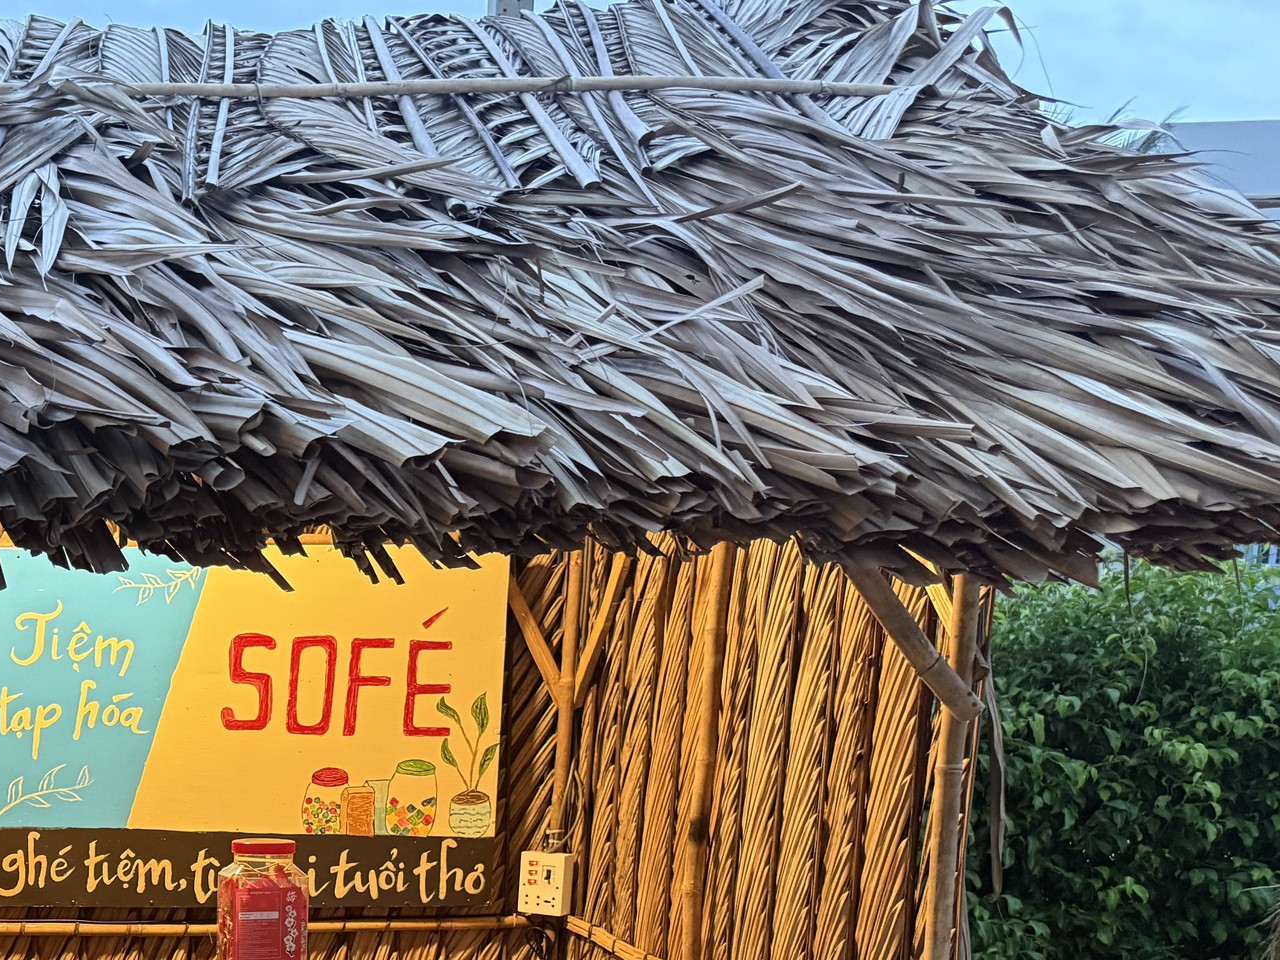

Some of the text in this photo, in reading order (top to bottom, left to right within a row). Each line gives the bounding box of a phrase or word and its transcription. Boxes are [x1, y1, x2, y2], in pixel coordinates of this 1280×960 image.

[8, 599, 134, 675] Tiệm
[221, 607, 453, 736] SOFÉ
[73, 679, 149, 739] hóa
[334, 847, 410, 900] tuổi
[417, 839, 486, 901] thơ
